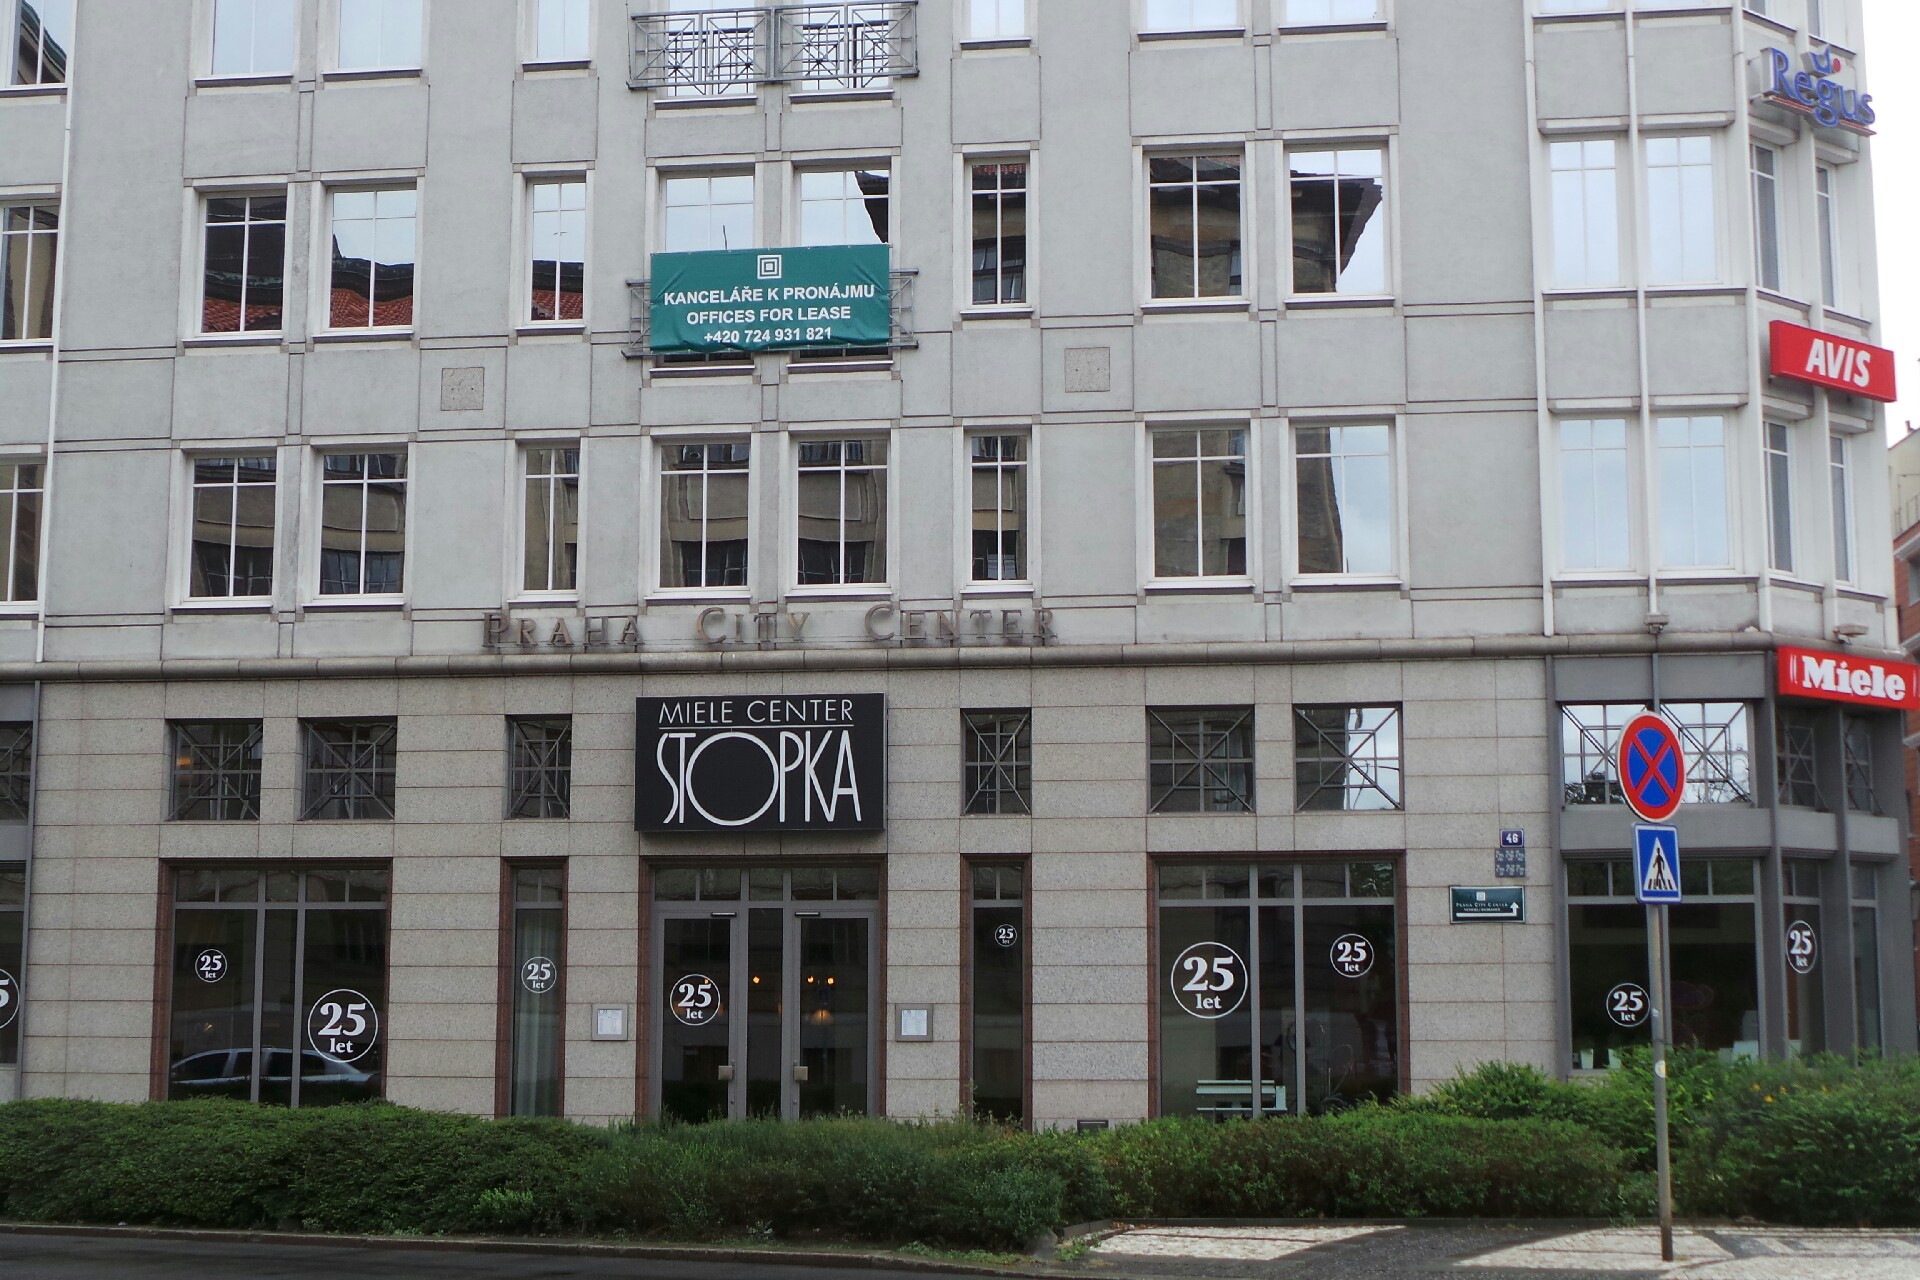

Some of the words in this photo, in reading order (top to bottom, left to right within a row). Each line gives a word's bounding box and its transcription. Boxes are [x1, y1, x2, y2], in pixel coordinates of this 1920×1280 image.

[1769, 47, 1876, 127] Regus
[664, 286, 763, 306] KANCELÁŘE
[767, 287, 779, 301] K
[783, 283, 875, 301] PRONÁJMU
[686, 309, 755, 325] OFFICES
[759, 307, 793, 322] FOR
[798, 306, 851, 320] LEASE
[704, 330, 740, 344] +420
[744, 328, 770, 342] 724
[774, 327, 800, 341] 931
[806, 326, 832, 340] 821
[1806, 338, 1871, 387] AVIS
[482, 611, 646, 648] PRAHA
[697, 607, 812, 644] CITY
[864, 603, 1058, 647] CENTER
[1802, 655, 1905, 701] Miele
[658, 701, 733, 724] MIELE
[747, 699, 853, 723] CENTER
[656, 730, 862, 826] STOPKA
[1505, 833, 1519, 843] 46
[998, 928, 1014, 938] 25
[1790, 930, 1812, 955] 25
[1337, 942, 1366, 962] 25
[200, 955, 222, 971] 25
[526, 963, 551, 981] 25
[1345, 962, 1359, 972] let
[205, 971, 217, 979] let
[1182, 956, 1234, 992] 25
[678, 983, 711, 1008] 25
[1196, 993, 1222, 1010] let
[1613, 991, 1643, 1012] 25
[317, 1002, 367, 1036] 25
[686, 1008, 703, 1020] let
[1620, 1011, 1636, 1022] let
[329, 1038, 354, 1053] let
